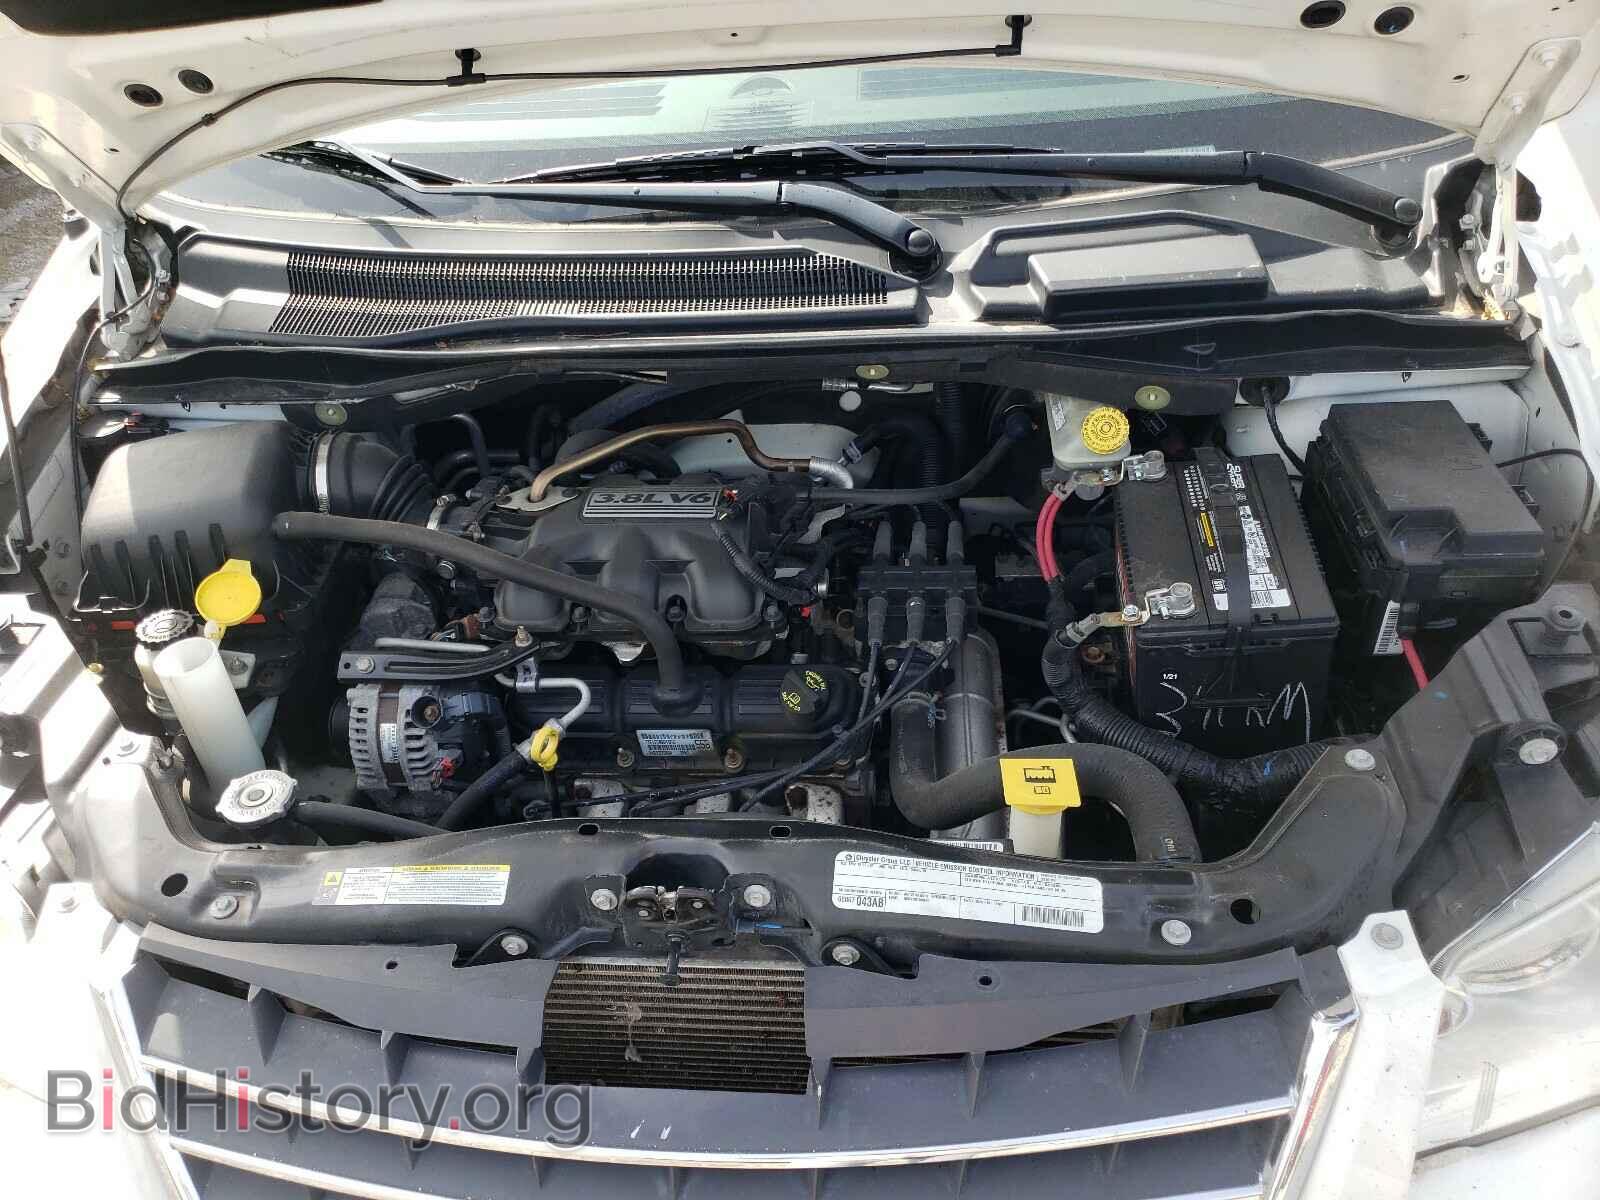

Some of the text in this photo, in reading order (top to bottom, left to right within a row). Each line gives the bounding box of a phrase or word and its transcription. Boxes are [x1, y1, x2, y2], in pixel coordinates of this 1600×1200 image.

[667, 493, 712, 504] V6
[856, 855, 879, 864] Chrysler
[915, 859, 938, 869] VEHICLE
[941, 861, 967, 872] EMISSION
[969, 866, 993, 876] CONTROL
[996, 869, 1035, 880] INFORMATION
